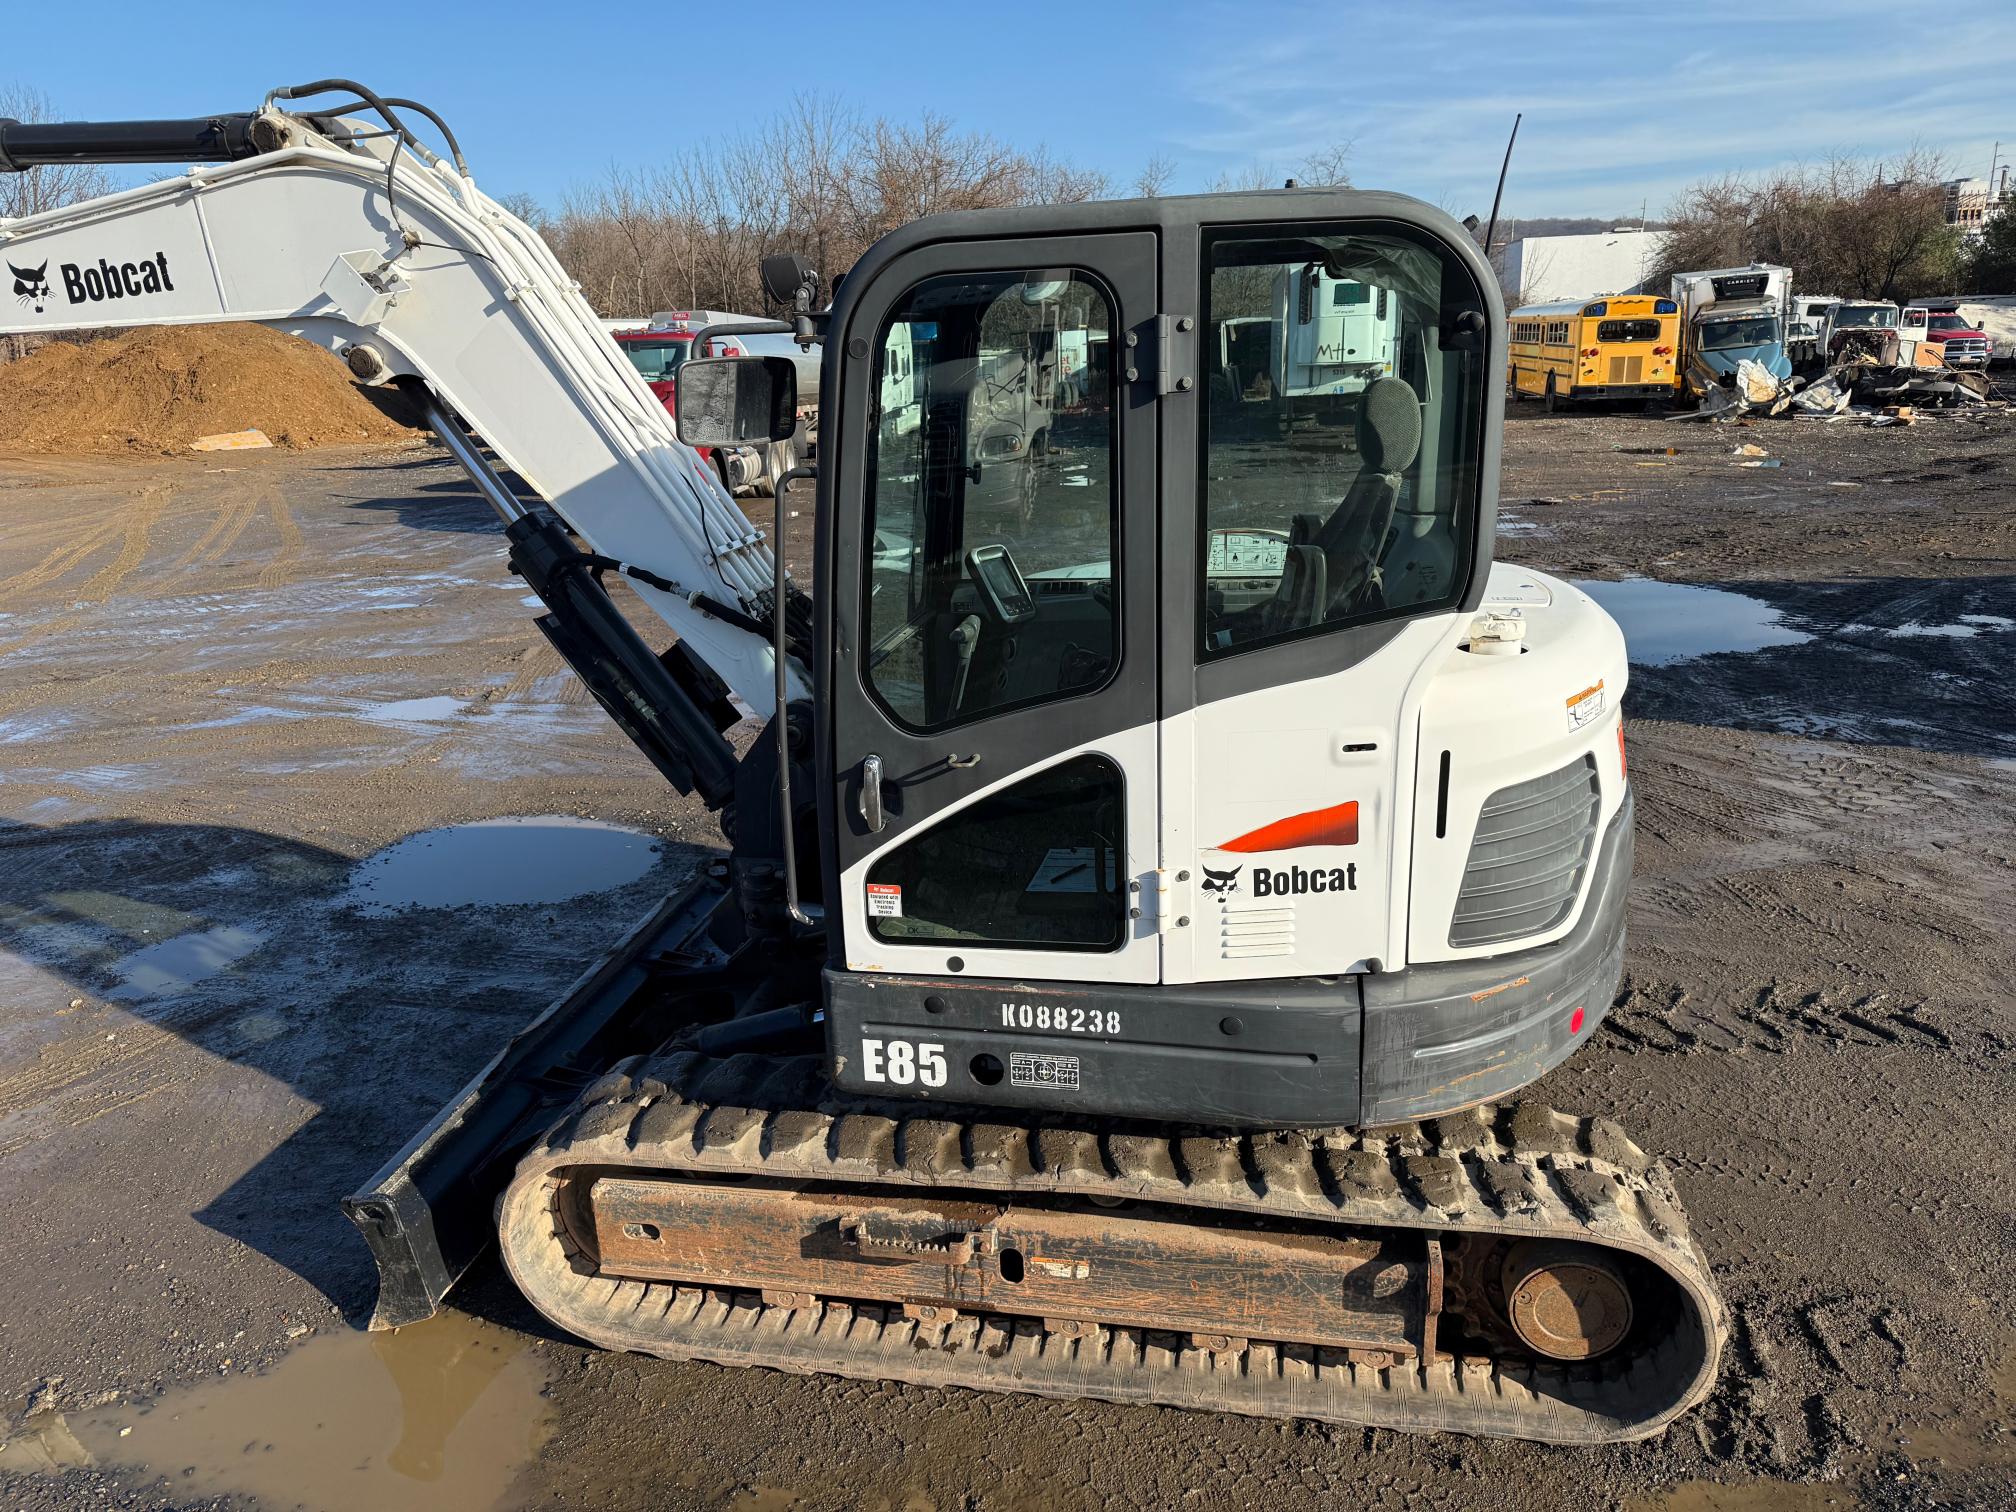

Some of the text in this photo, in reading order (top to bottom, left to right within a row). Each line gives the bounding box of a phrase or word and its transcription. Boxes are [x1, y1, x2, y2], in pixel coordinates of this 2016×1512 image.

[60, 251, 175, 304] Bobcat
[1253, 863, 1357, 897] Bobcat
[1001, 1003, 1121, 1034] K088238
[862, 1038, 948, 1088] E85
